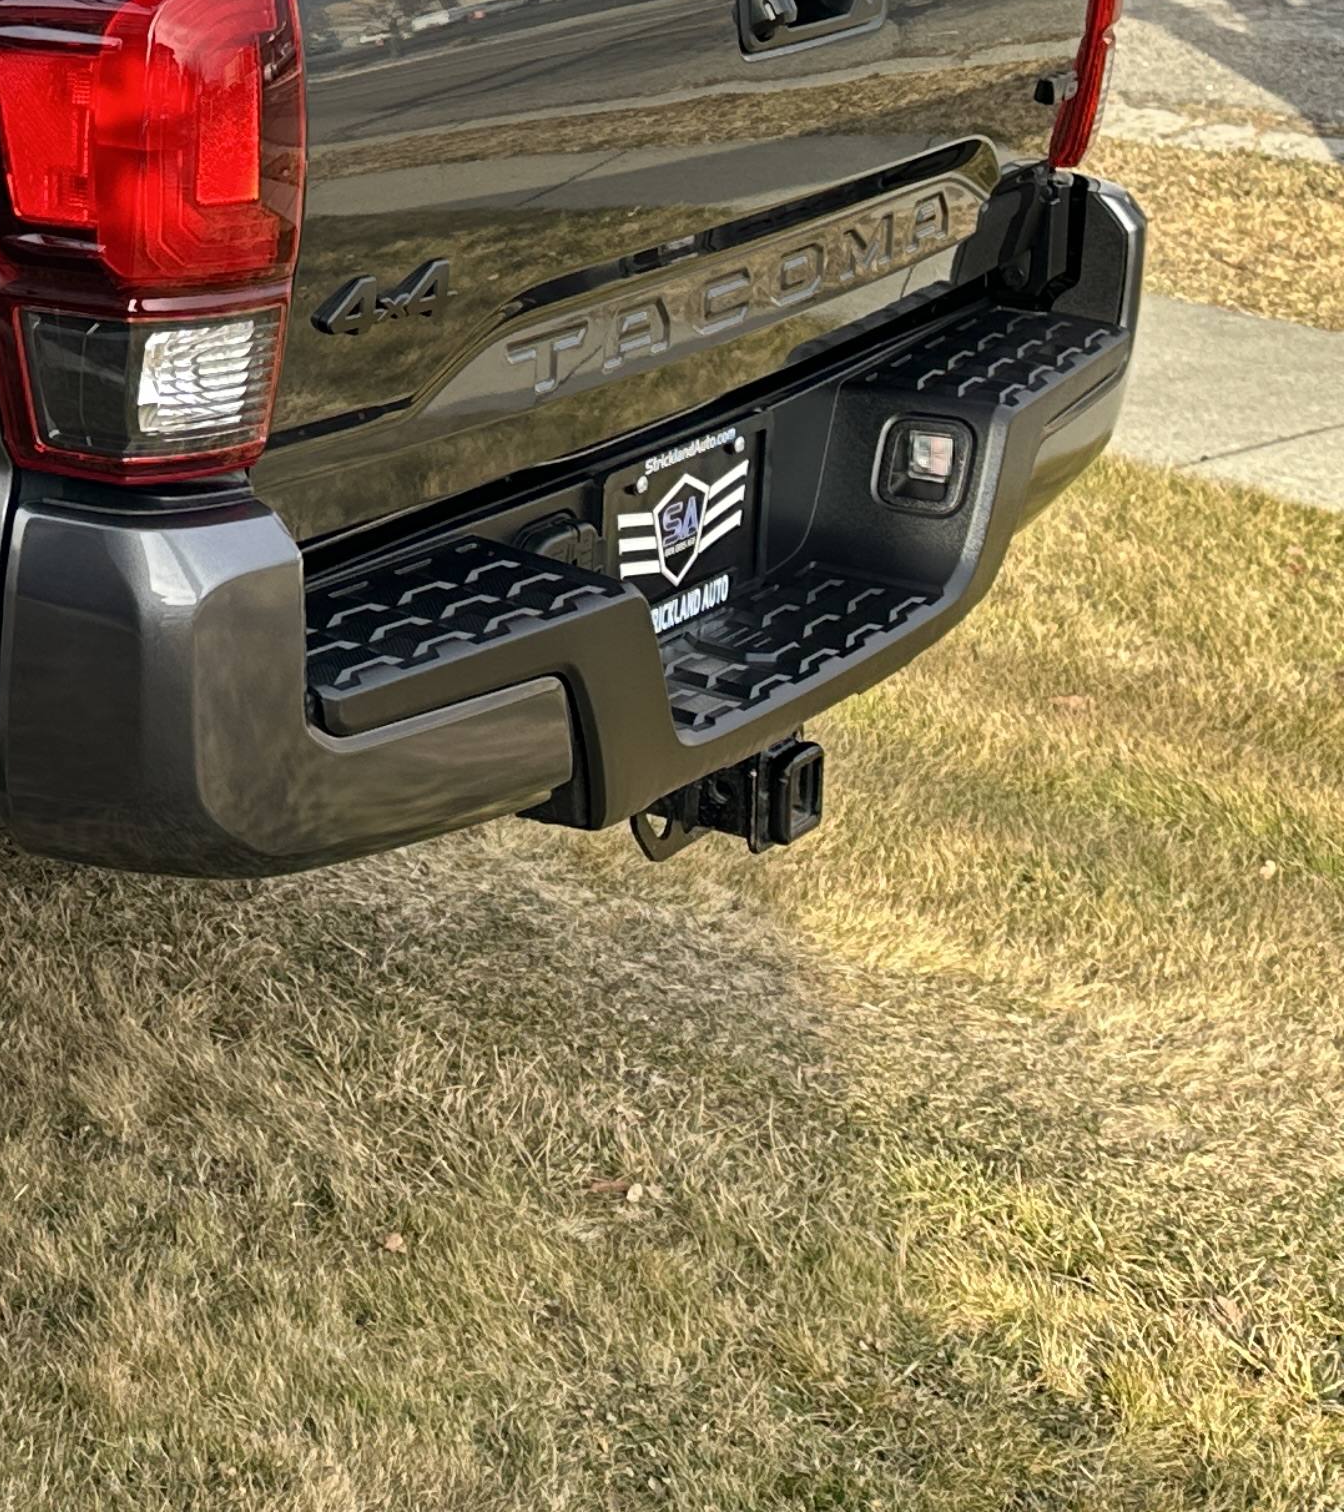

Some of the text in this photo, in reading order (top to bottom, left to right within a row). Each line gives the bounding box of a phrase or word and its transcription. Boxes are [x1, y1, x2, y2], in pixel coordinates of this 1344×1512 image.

[505, 191, 949, 395] TACOMA
[645, 427, 736, 476] StricklandAuto.com
[662, 495, 700, 548] SA
[650, 574, 729, 635] RICKLAND AUTO
